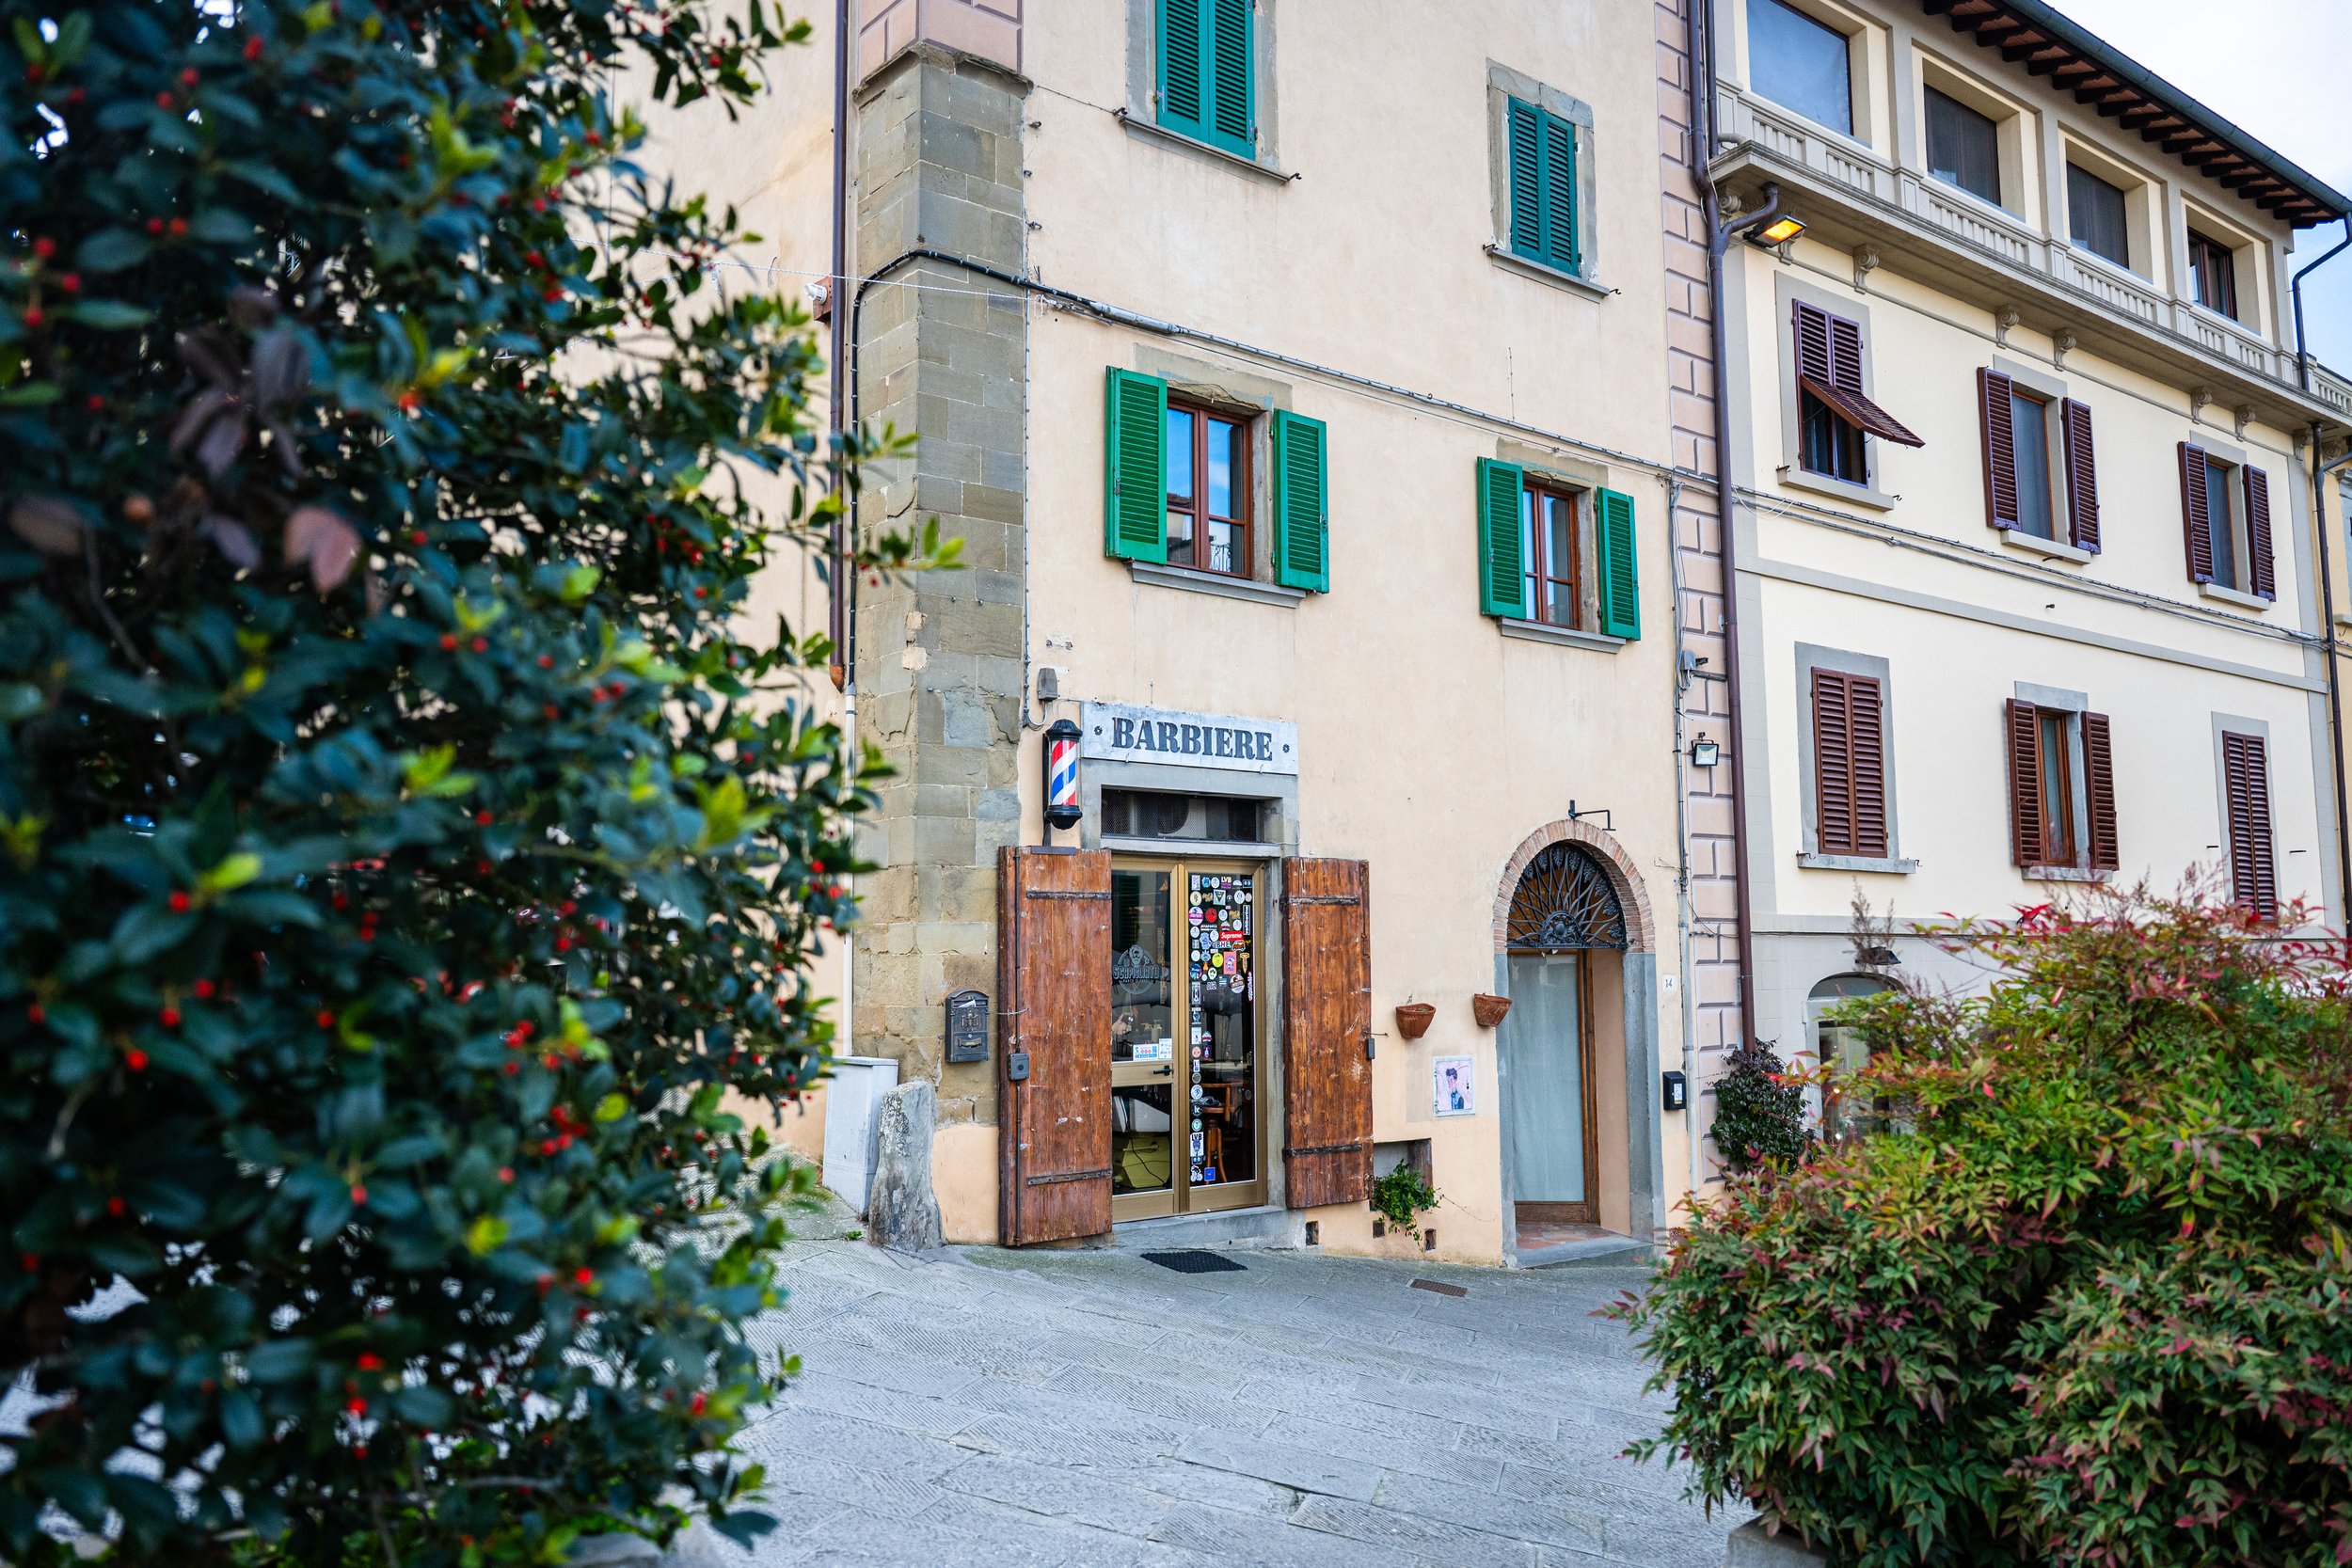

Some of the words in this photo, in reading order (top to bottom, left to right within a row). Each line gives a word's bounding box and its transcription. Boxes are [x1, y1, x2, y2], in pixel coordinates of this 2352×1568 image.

[1111, 717, 1273, 761] BARBIERE
[1113, 964, 1160, 980] SCAPIGLIATO
[1665, 977, 1673, 989] 14
[1191, 1132, 1202, 1141] LVB
